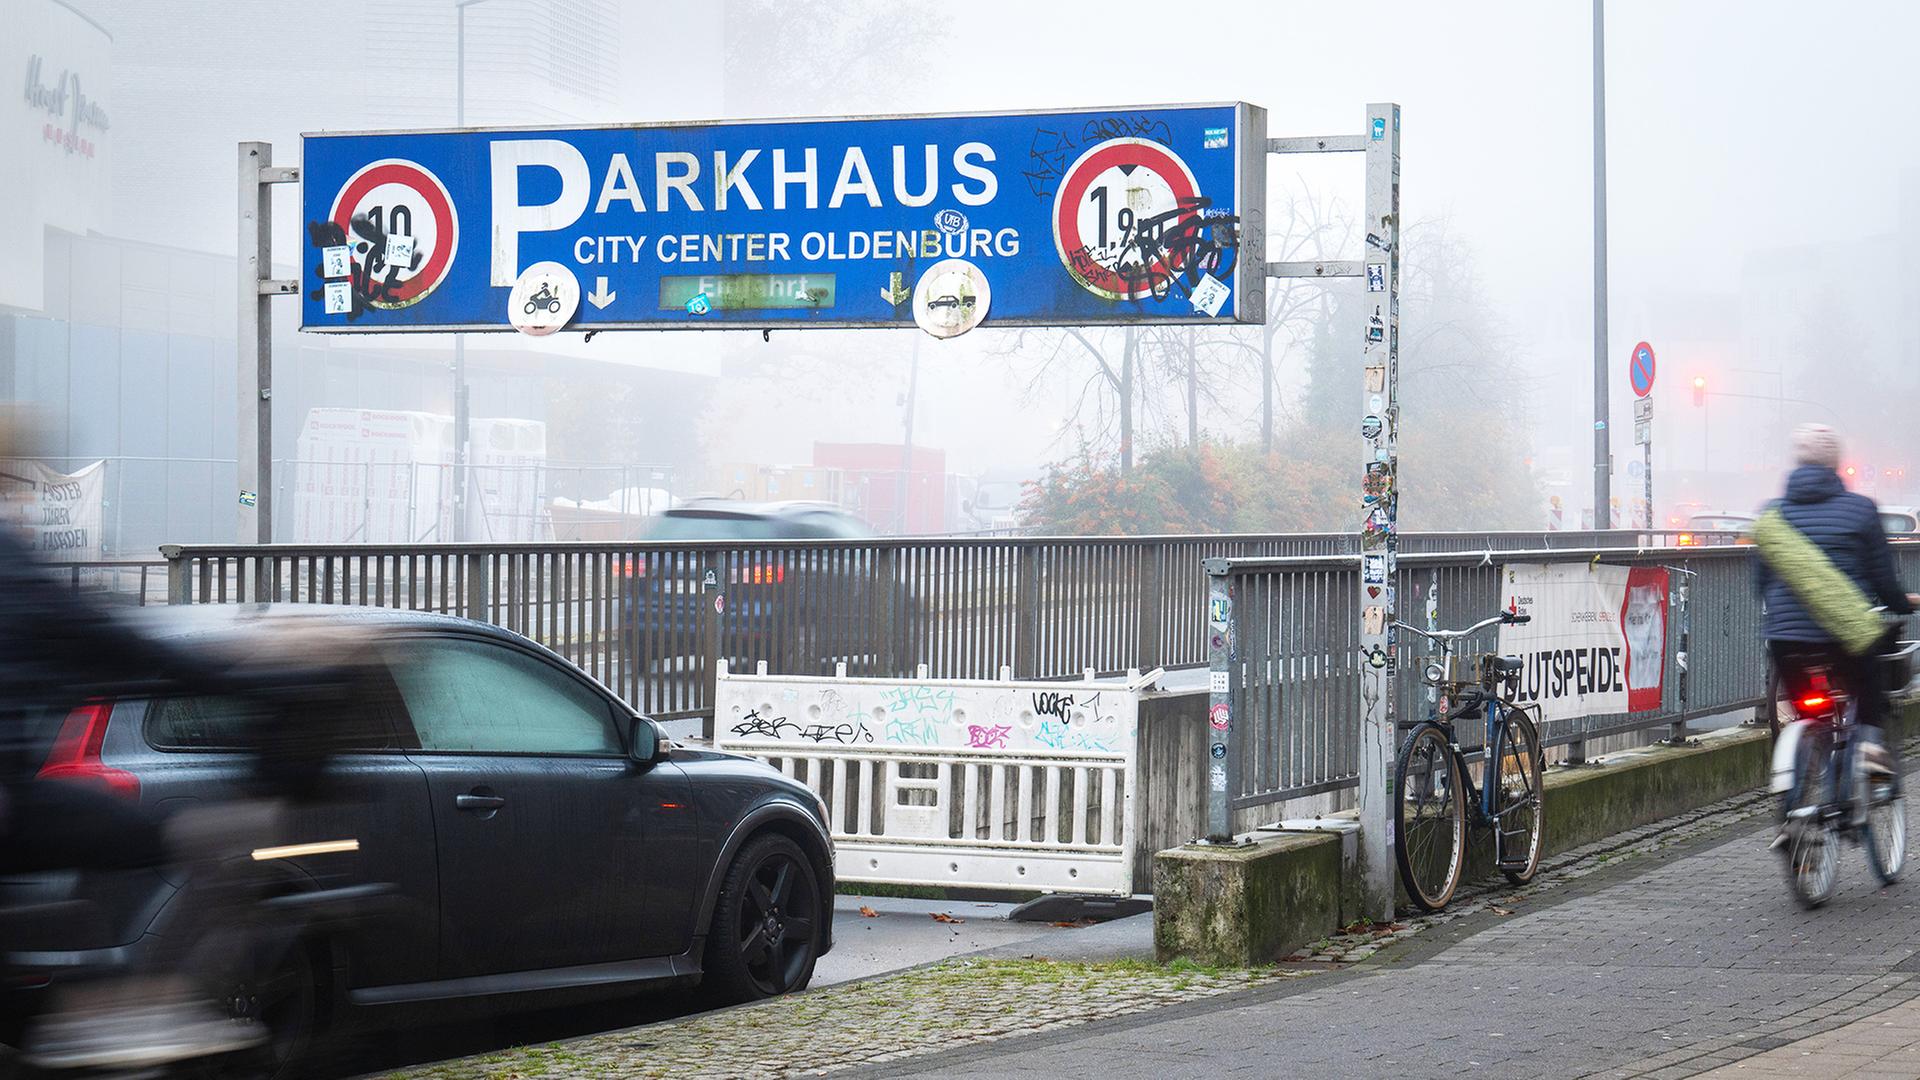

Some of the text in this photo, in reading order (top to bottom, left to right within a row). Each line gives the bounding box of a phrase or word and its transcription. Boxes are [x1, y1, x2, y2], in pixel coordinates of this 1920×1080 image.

[490, 139, 998, 288] PARKHAUS
[573, 226, 1020, 265] CITY CENTER OLDENBURG
